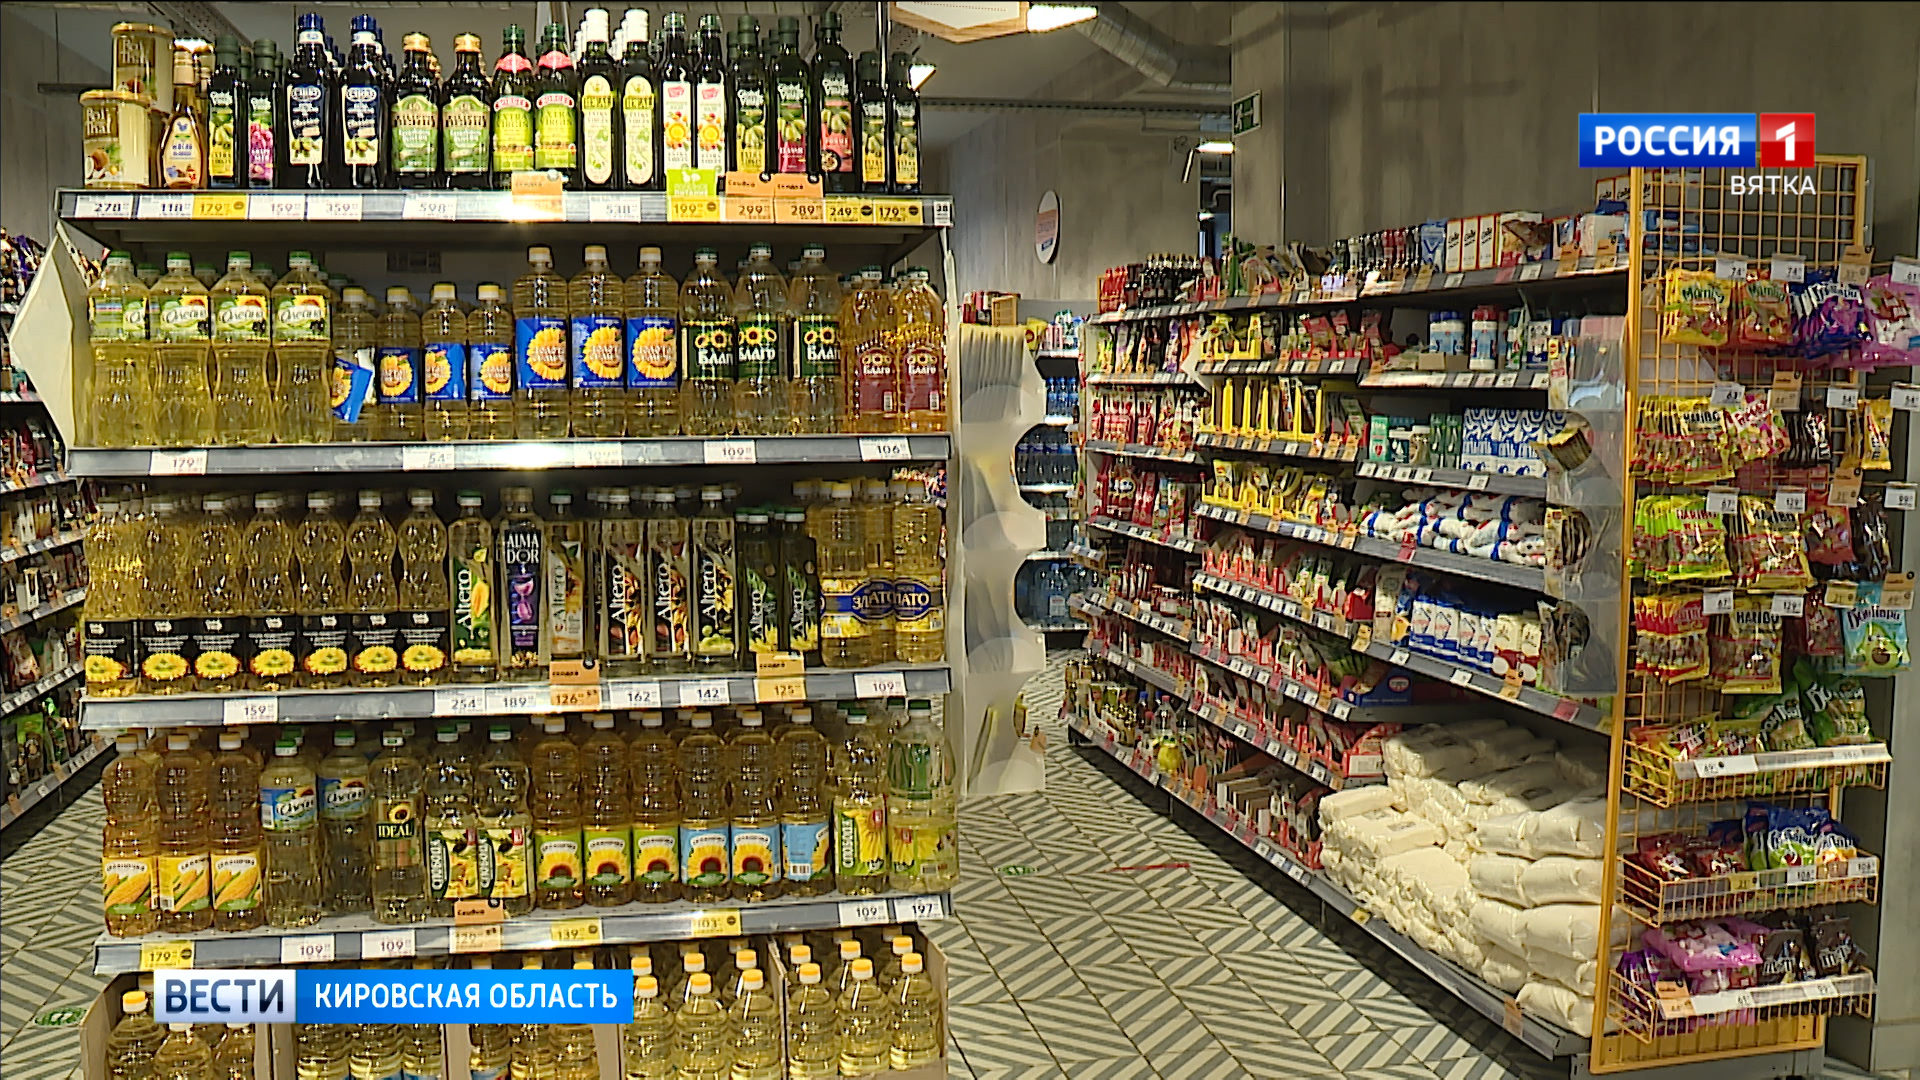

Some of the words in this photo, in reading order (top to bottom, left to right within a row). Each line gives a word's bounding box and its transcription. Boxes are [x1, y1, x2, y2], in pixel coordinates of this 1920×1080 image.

[94, 202, 122, 213] 278
[200, 202, 224, 214] 179
[271, 202, 294, 214] 159
[674, 203, 698, 214] 199
[738, 204, 765, 217] 299
[878, 206, 900, 218] 179
[863, 365, 891, 375] БЛАГО
[908, 365, 937, 375] БЛАГО
[721, 447, 746, 458] 109
[876, 445, 901, 455] 106
[172, 457, 195, 469] 179
[506, 533, 540, 549] ALMA
[609, 564, 626, 623] Altero
[656, 563, 672, 622] Altero
[457, 569, 472, 631] Altero
[750, 589, 763, 637] Altero
[697, 686, 721, 699] 142
[873, 681, 895, 693] 109
[555, 693, 578, 705] 126
[627, 690, 651, 703] 162
[244, 705, 267, 717] 159
[377, 823, 413, 838] IDEAL
[855, 907, 878, 918] 109
[911, 902, 933, 914] 197
[299, 944, 323, 956] 109
[380, 940, 404, 952] 109
[150, 951, 172, 963] 179
